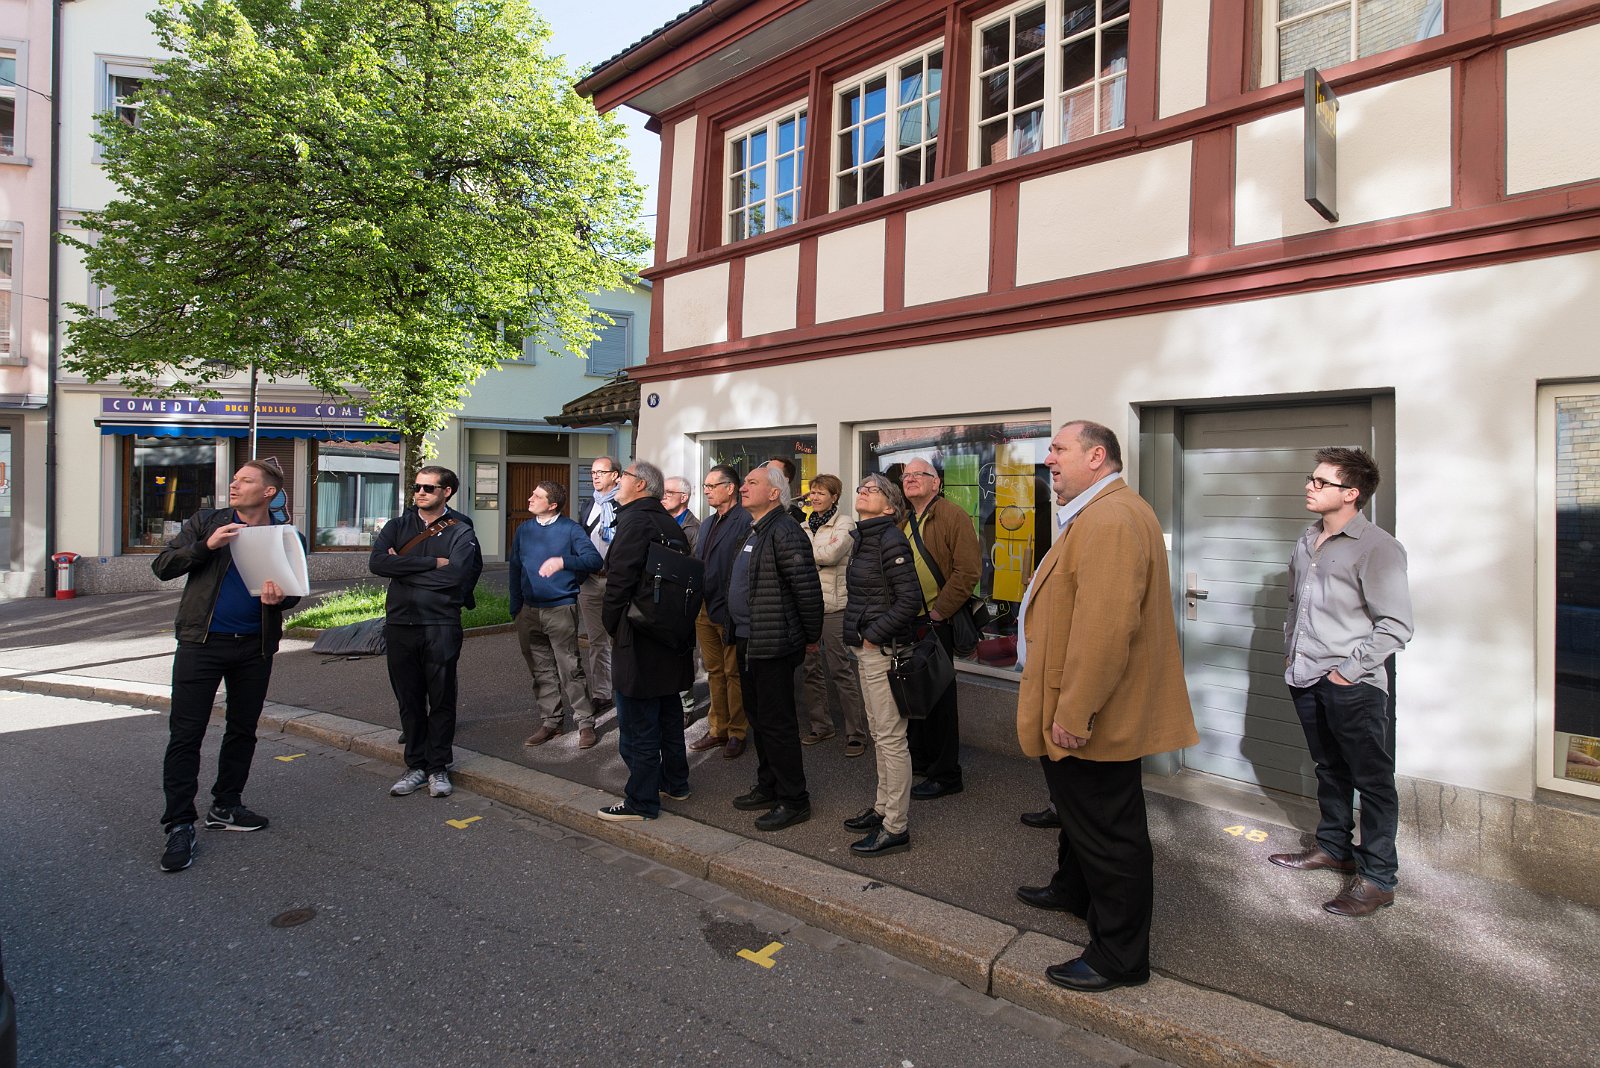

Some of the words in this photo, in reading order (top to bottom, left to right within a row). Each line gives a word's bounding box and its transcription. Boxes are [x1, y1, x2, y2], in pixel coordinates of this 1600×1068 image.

[113, 400, 207, 412] COMEDIA
[225, 404, 297, 414] BUCHANDLUNG
[1223, 825, 1269, 843] 48
